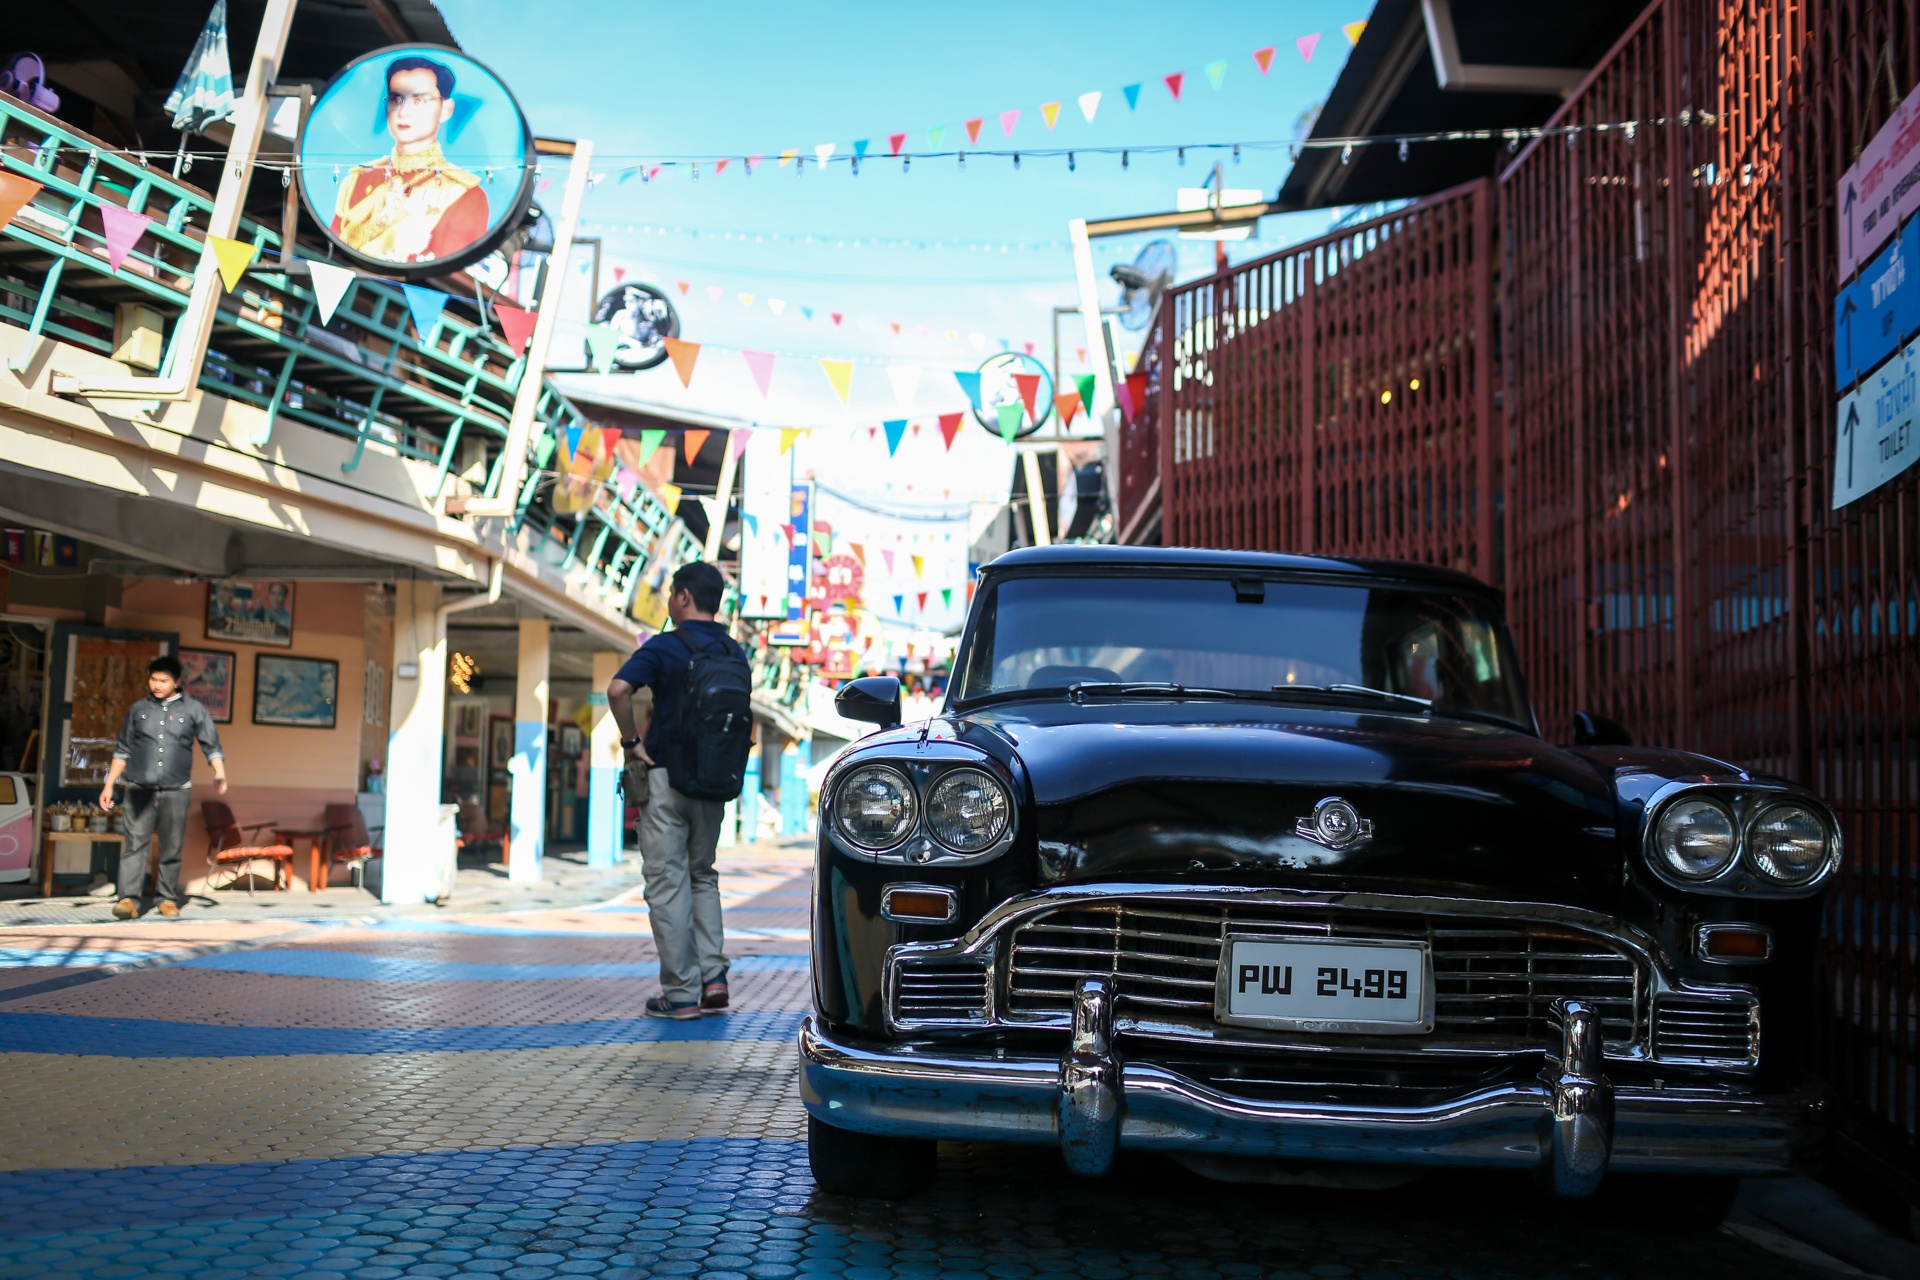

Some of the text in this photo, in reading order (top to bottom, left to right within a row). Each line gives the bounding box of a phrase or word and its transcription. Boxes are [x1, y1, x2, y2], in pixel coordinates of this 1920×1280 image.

[1863, 208, 1877, 237] FOOD
[1880, 194, 1890, 220] AND
[1876, 347, 1915, 429] ห้องน้ำ
[1879, 420, 1912, 464] TOILET
[1238, 964, 1407, 999] PW 2499
